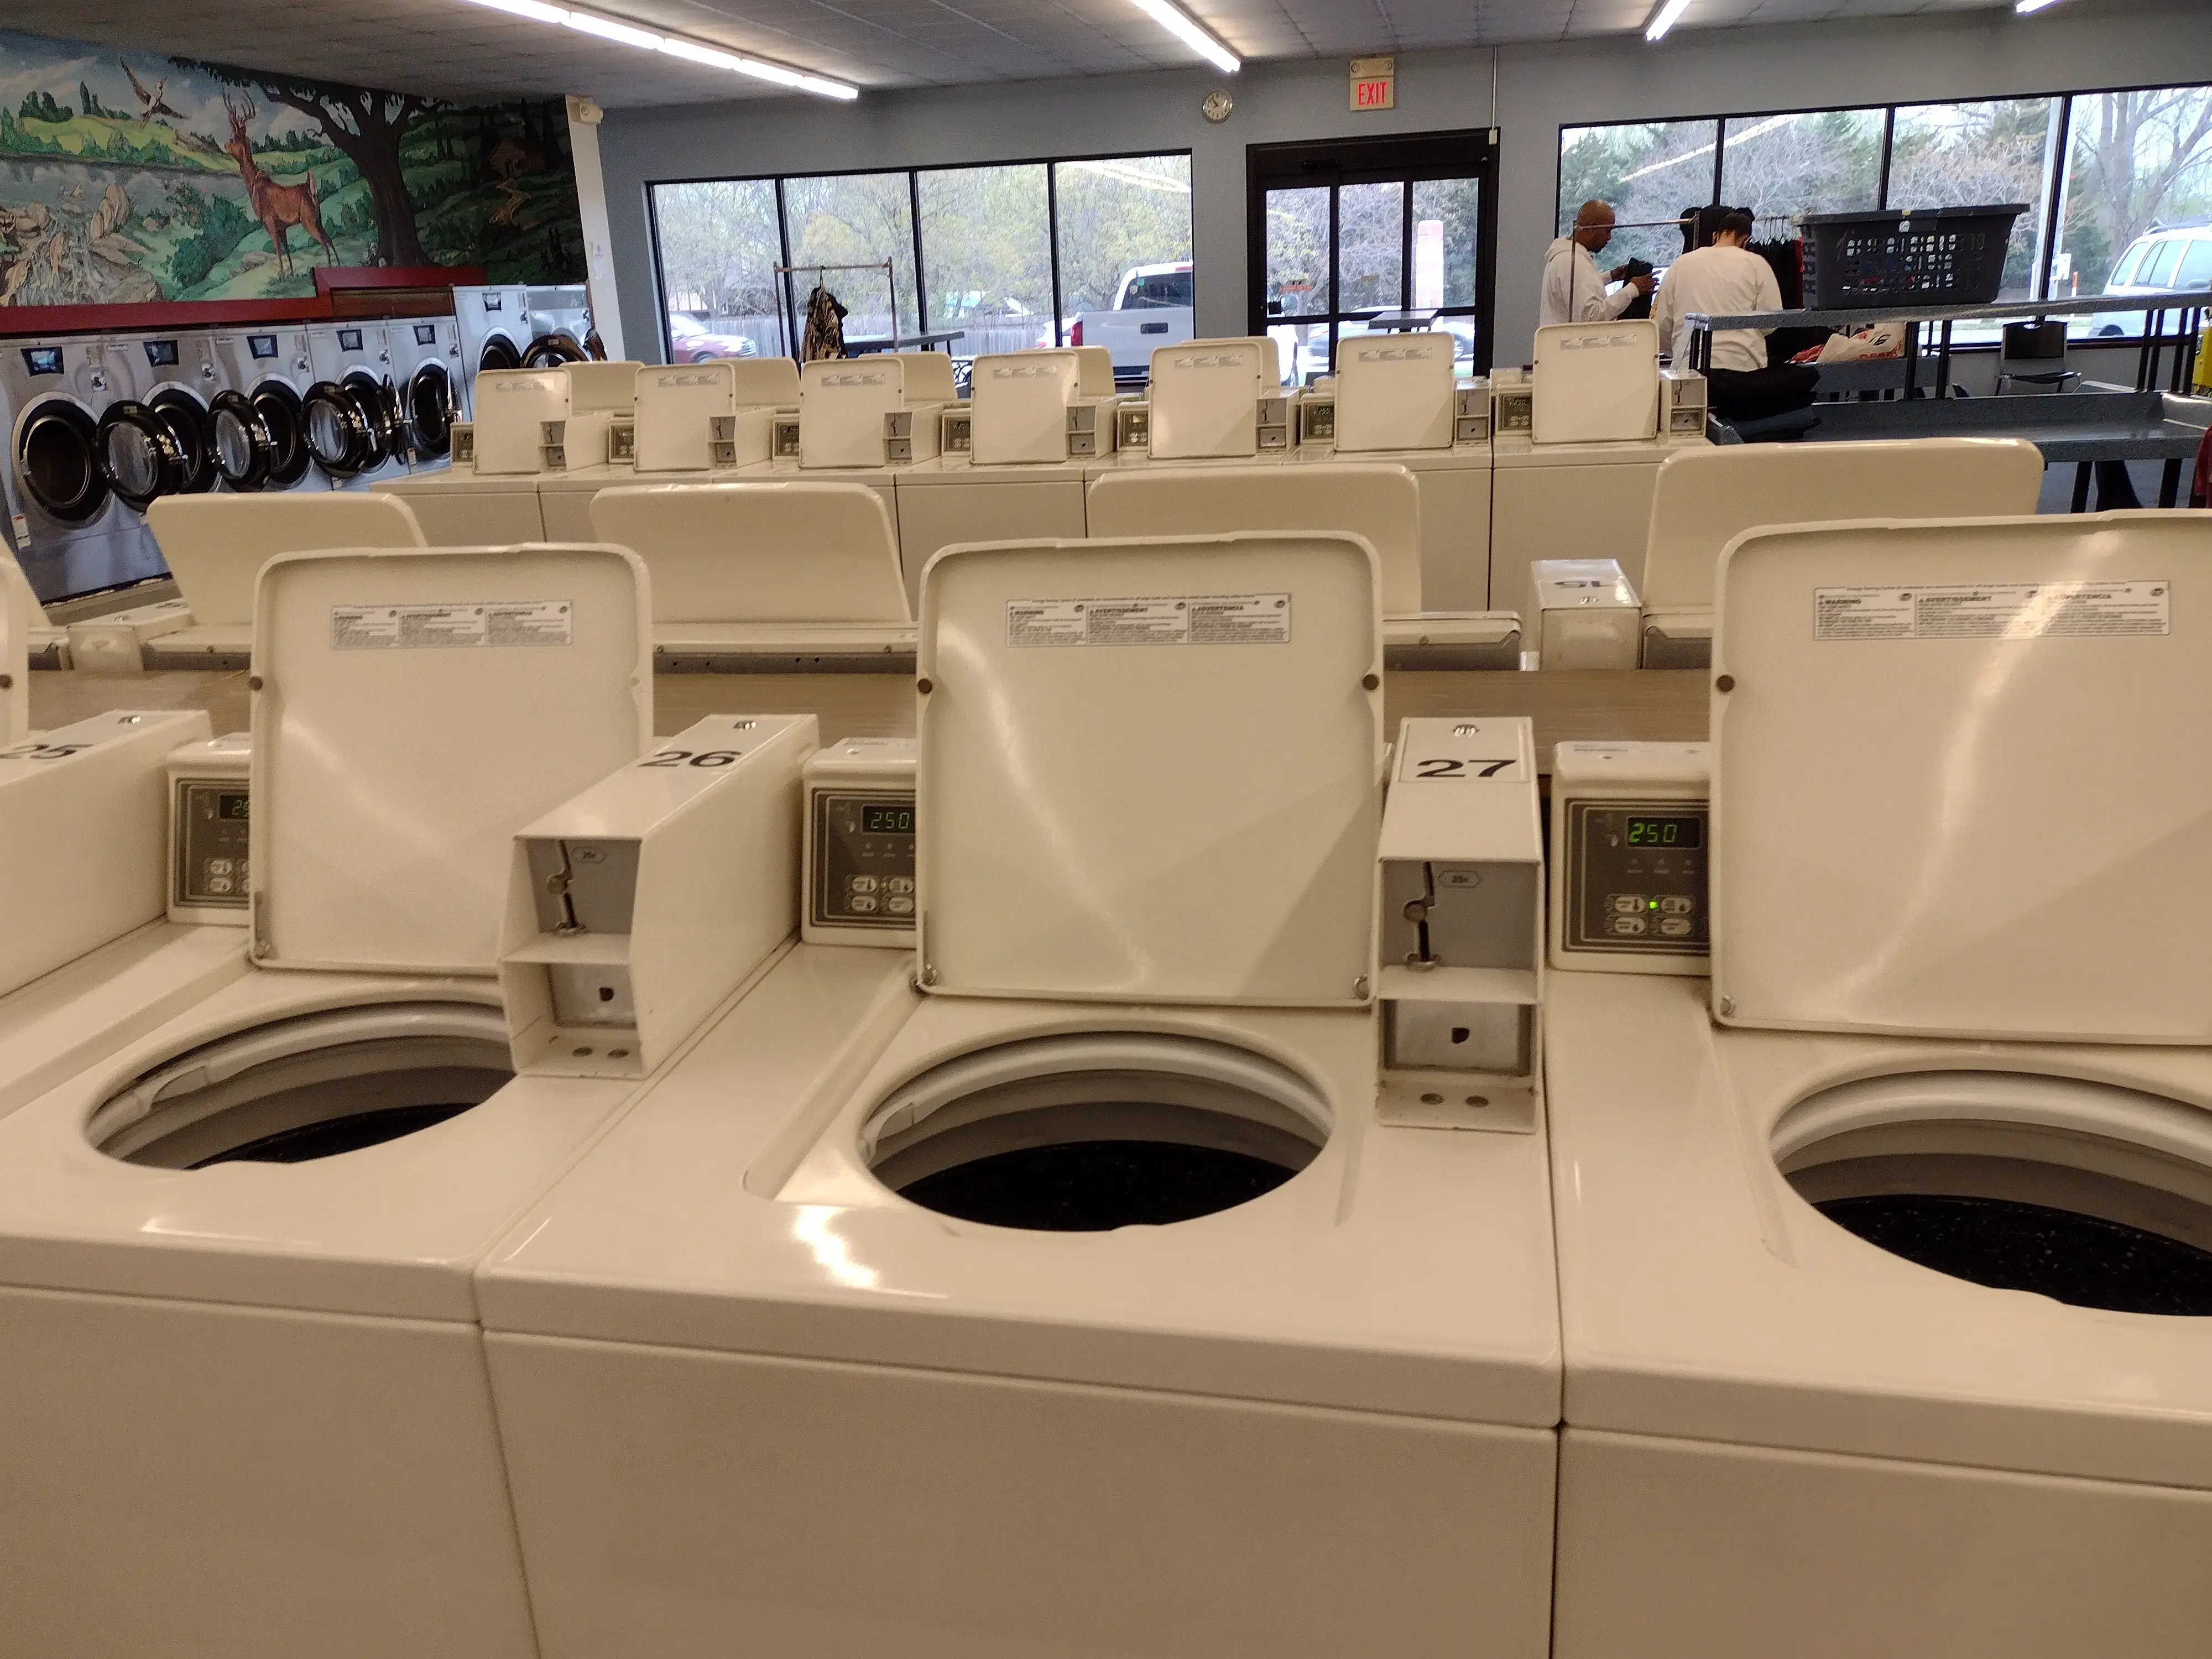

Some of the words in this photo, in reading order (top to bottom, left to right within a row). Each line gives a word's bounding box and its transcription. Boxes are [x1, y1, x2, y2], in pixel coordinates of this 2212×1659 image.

[1358, 82, 1387, 105] EXIT
[0, 744, 93, 760] 25
[638, 750, 742, 768] 26
[1416, 759, 1516, 778] 27
[870, 812, 910, 830] 250
[1628, 822, 1677, 843] 250
